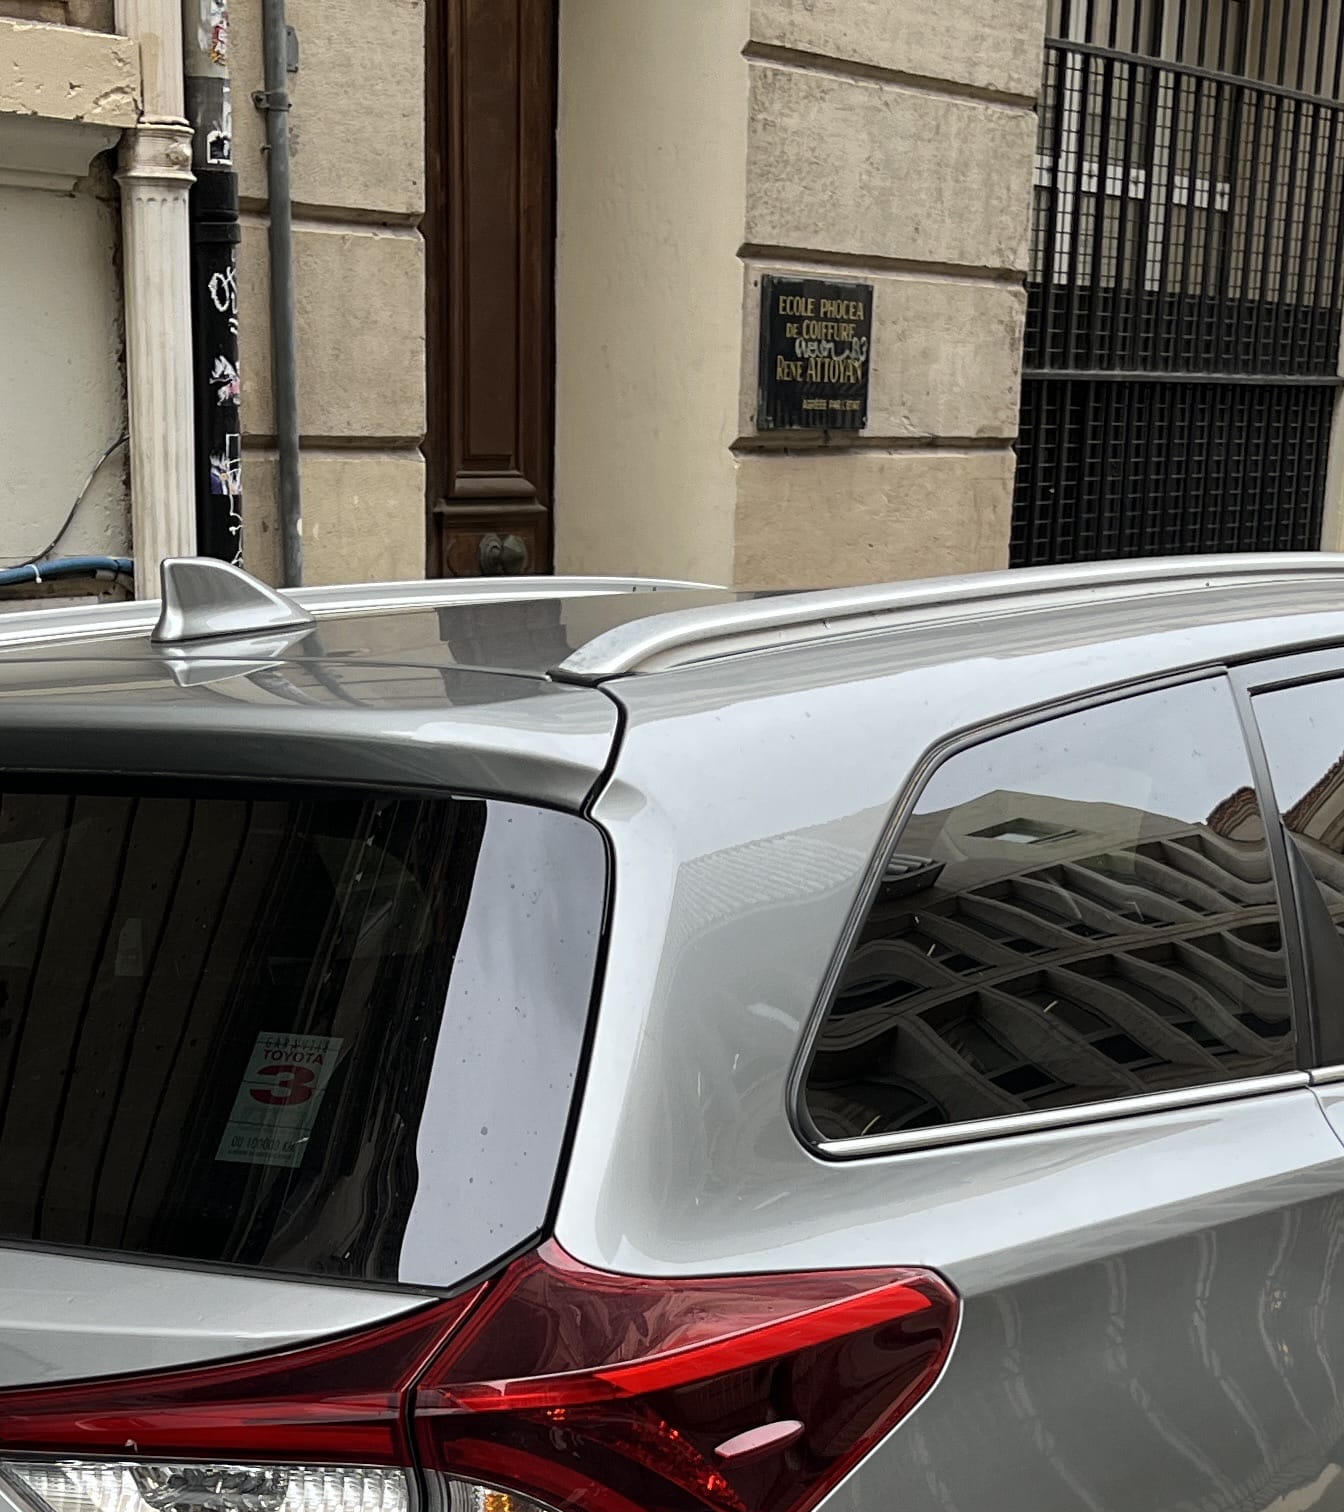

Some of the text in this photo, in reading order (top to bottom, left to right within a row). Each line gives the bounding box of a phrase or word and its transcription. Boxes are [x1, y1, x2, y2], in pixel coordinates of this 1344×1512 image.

[778, 295, 864, 321] ECOLE PHOCEA
[786, 320, 856, 341] DE COIFFURE
[806, 357, 863, 384] ATTOYAN
[263, 1049, 324, 1066] TOYOTA
[250, 1065, 316, 1106] 3
